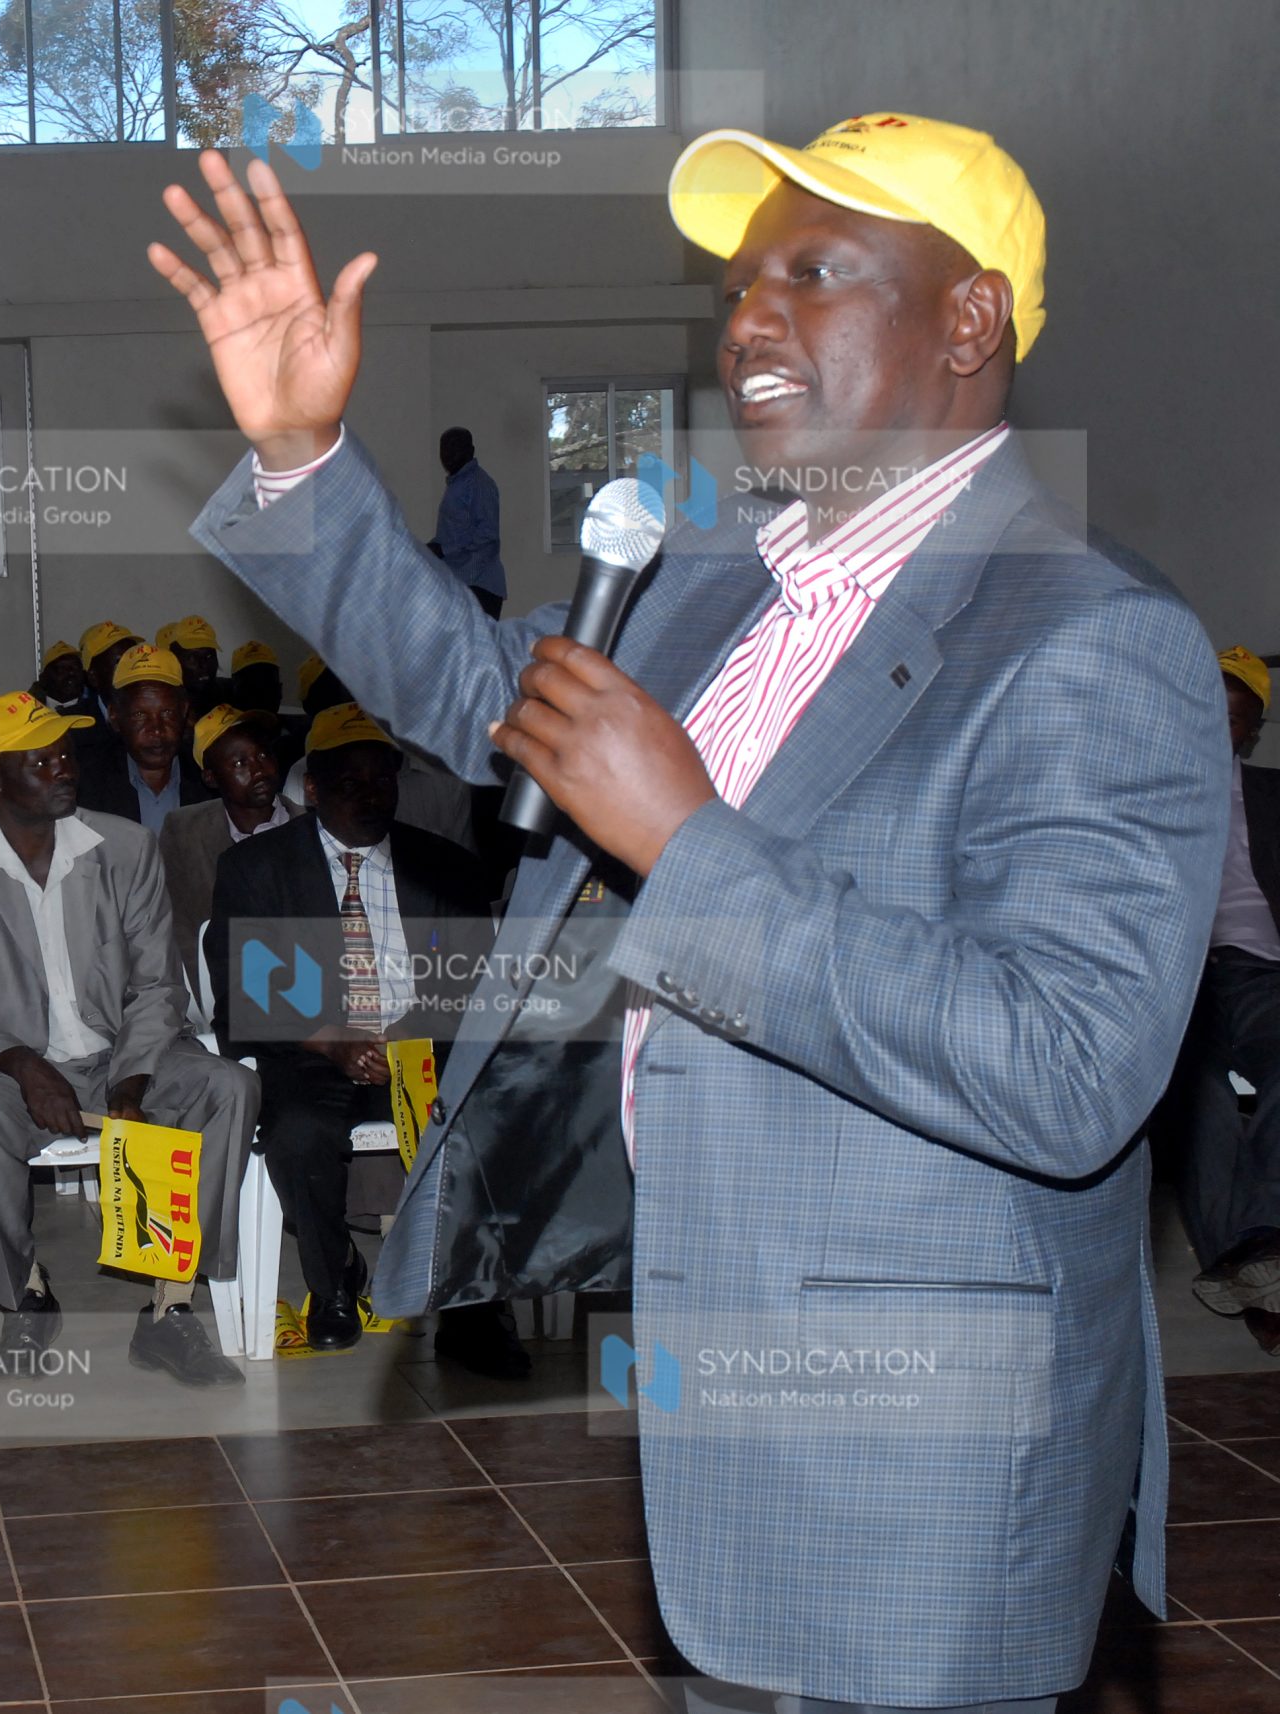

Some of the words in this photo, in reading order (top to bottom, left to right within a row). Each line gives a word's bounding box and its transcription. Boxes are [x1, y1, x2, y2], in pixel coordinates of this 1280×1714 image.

[113, 1137, 122, 1184] KUSEMA
[114, 1187, 122, 1203] NA
[170, 1149, 195, 1273] URP
[114, 1206, 125, 1258] KUTENDA
